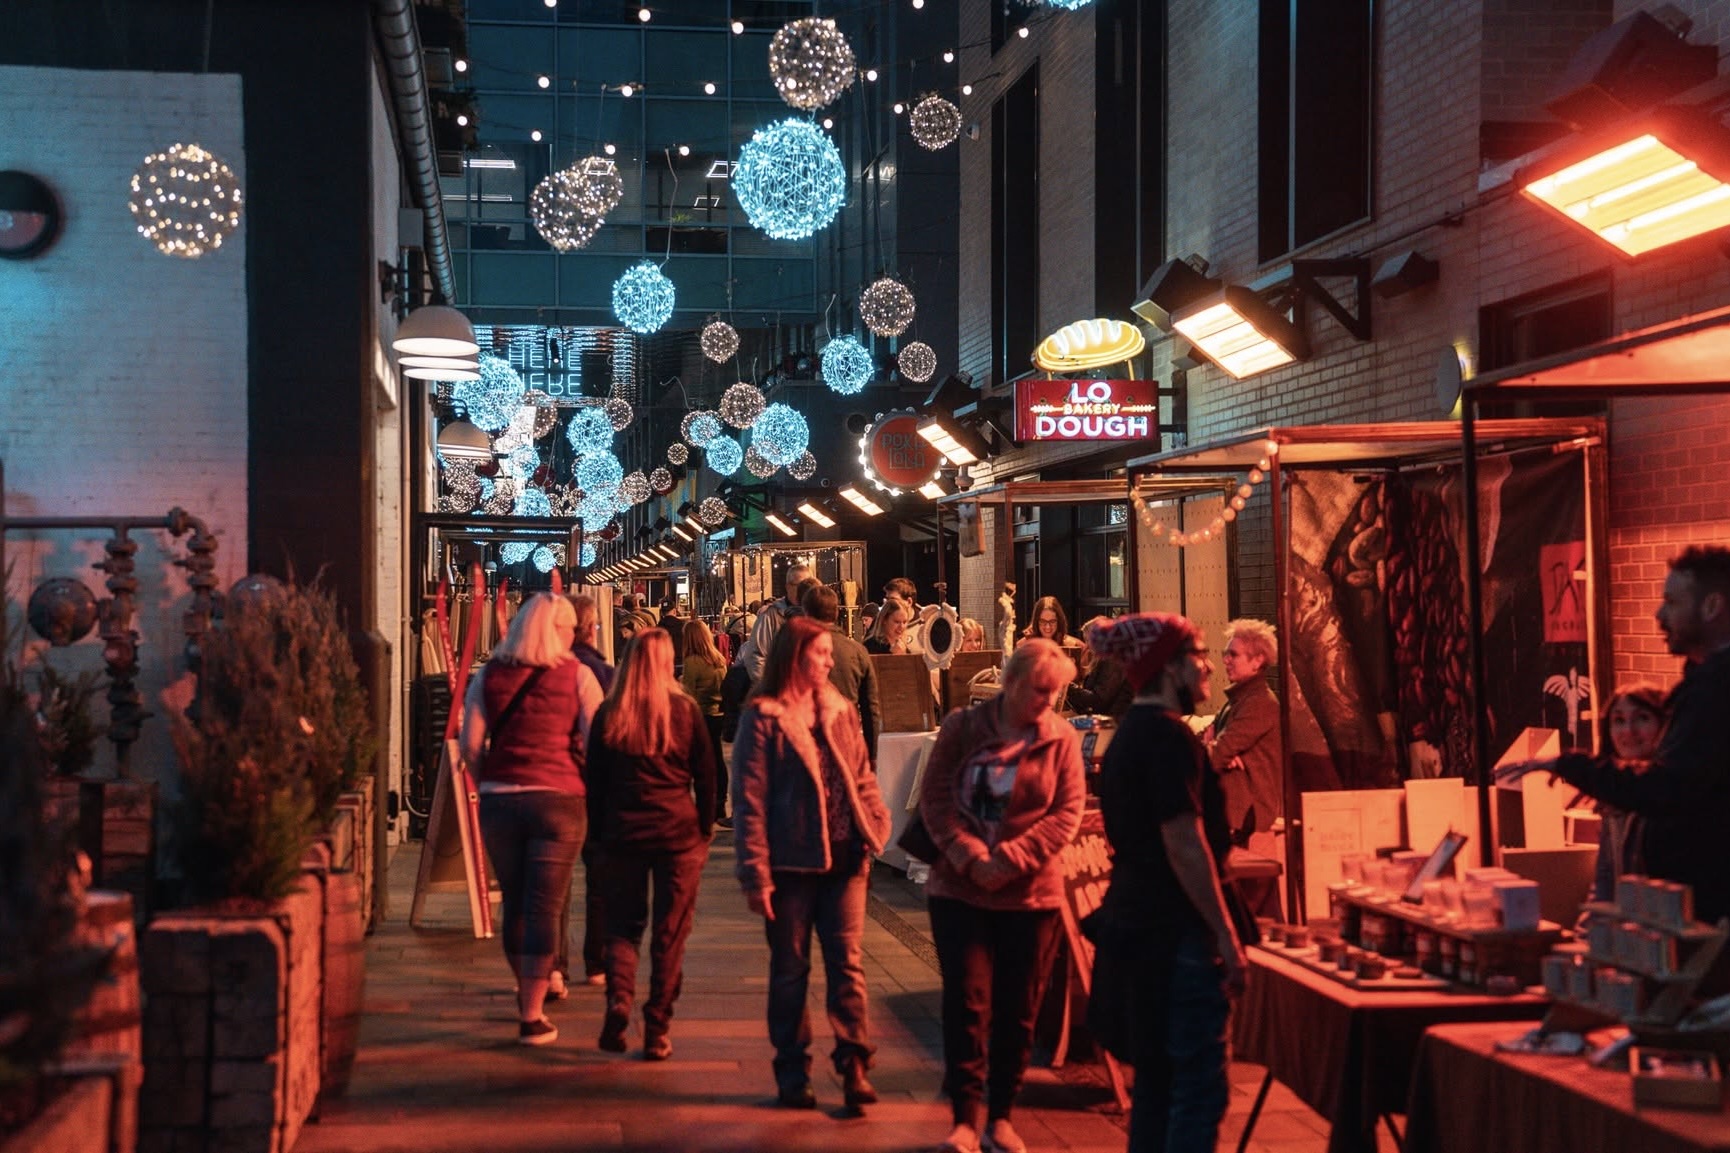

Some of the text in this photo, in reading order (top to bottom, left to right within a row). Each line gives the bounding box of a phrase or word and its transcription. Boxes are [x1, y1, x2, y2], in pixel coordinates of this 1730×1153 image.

[1071, 382, 1112, 404] LO
[1063, 403, 1121, 415] BAKERY
[1035, 416, 1148, 437] DOUGH
